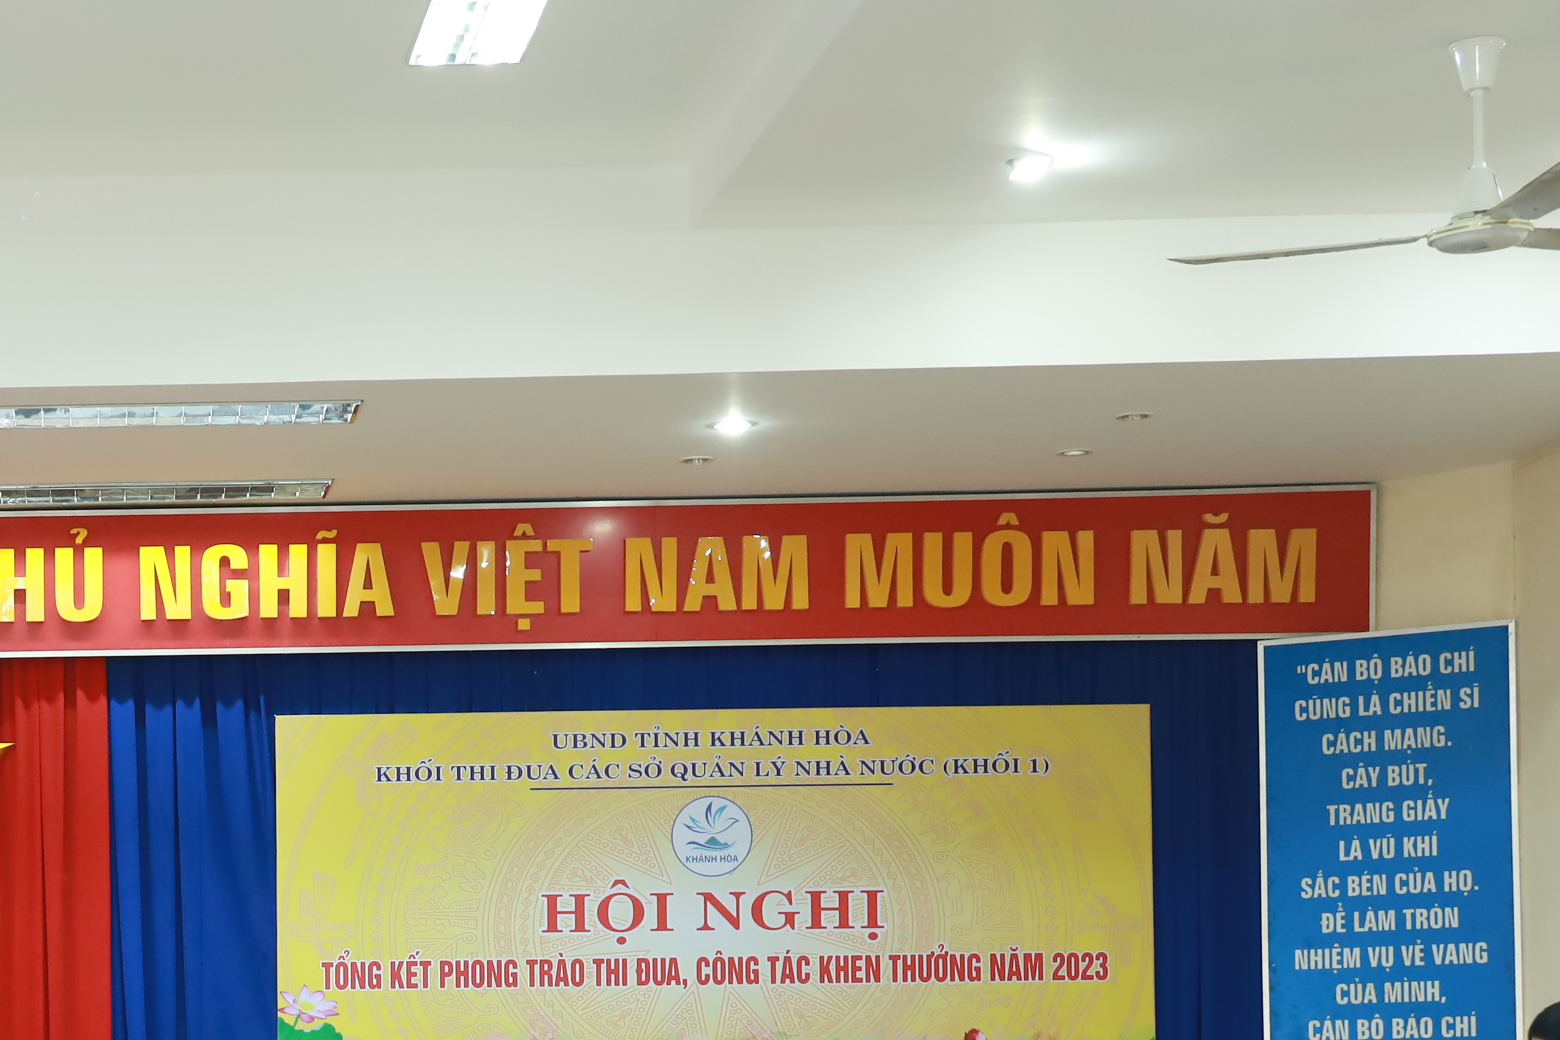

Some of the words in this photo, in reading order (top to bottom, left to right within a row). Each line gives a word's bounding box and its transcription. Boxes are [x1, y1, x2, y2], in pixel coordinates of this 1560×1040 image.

[139, 529, 396, 621] NGHĨA
[421, 523, 595, 631] VIỆT
[625, 534, 810, 612] NAM
[846, 512, 1095, 609] MUÔN
[1130, 512, 1318, 605] NĂM
[1356, 654, 1382, 684] BỘ
[1390, 651, 1432, 678] BÁO
[1440, 646, 1475, 674] CHÍ
[1294, 696, 1350, 721] CŨNG
[1358, 690, 1382, 716] LÀ
[1389, 682, 1451, 714] CHIẾN
[1459, 683, 1480, 708] SĨ
[551, 732, 627, 749] UBND
[635, 726, 700, 748] TỈNH
[709, 726, 804, 747] KHÁNH
[814, 725, 870, 746] HÒA
[1322, 728, 1376, 754] CÁCH
[1384, 725, 1452, 754] MẠNG.
[376, 759, 443, 782] KHỐI
[451, 764, 498, 781] THI
[505, 763, 560, 780] ĐUA
[568, 759, 622, 780] CÁC
[628, 758, 662, 779] SỞ
[670, 755, 746, 782] QUẢN
[753, 756, 786, 777] LÝ
[794, 756, 852, 776] NHÀ
[859, 753, 934, 776] NƯỚC
[942, 751, 1021, 776] (KHỐI
[1029, 757, 1050, 776] 1)
[1341, 763, 1380, 789] CÂY
[1388, 760, 1433, 786] BÚT,
[1326, 801, 1394, 826] TRANG
[1402, 790, 1450, 821] GIẤY
[686, 853, 717, 863] KHÁNH
[720, 853, 738, 862] HÒA
[1339, 836, 1362, 861] LÀ
[1368, 834, 1394, 860] VŨ
[1403, 830, 1438, 857] KHÍ
[1301, 870, 1340, 898] SẮC
[1347, 871, 1387, 897] BÉN
[1394, 867, 1436, 894] CỦA
[1444, 869, 1479, 896] HỌ.
[541, 879, 674, 945] HỘI
[697, 889, 885, 940] NGHỊ
[1320, 902, 1348, 933] ĐỂ
[1354, 906, 1395, 932] LÀM
[1403, 902, 1459, 930] TRÒN
[322, 950, 381, 990] TỔNG
[391, 951, 431, 989] KẾT
[440, 959, 518, 988] PHONG
[526, 952, 585, 988] TRÀO
[593, 958, 628, 987] THI
[636, 957, 688, 989] ĐUA,
[696, 950, 759, 985] CÔNG
[768, 951, 810, 984] TÁC
[819, 954, 881, 983] KHEN
[889, 943, 981, 983] THƯỞNG
[990, 947, 1043, 982] NĂM
[1052, 952, 1109, 981] 2023
[1295, 944, 1360, 974] NHIỆM
[1368, 945, 1394, 972] VỤ
[1432, 942, 1488, 965] VANG
[1336, 978, 1377, 1004] CỦA
[1384, 978, 1446, 1003] MÌNH,
[1392, 1014, 1434, 1039] BÁO
[1441, 1011, 1476, 1038] CHÍ
